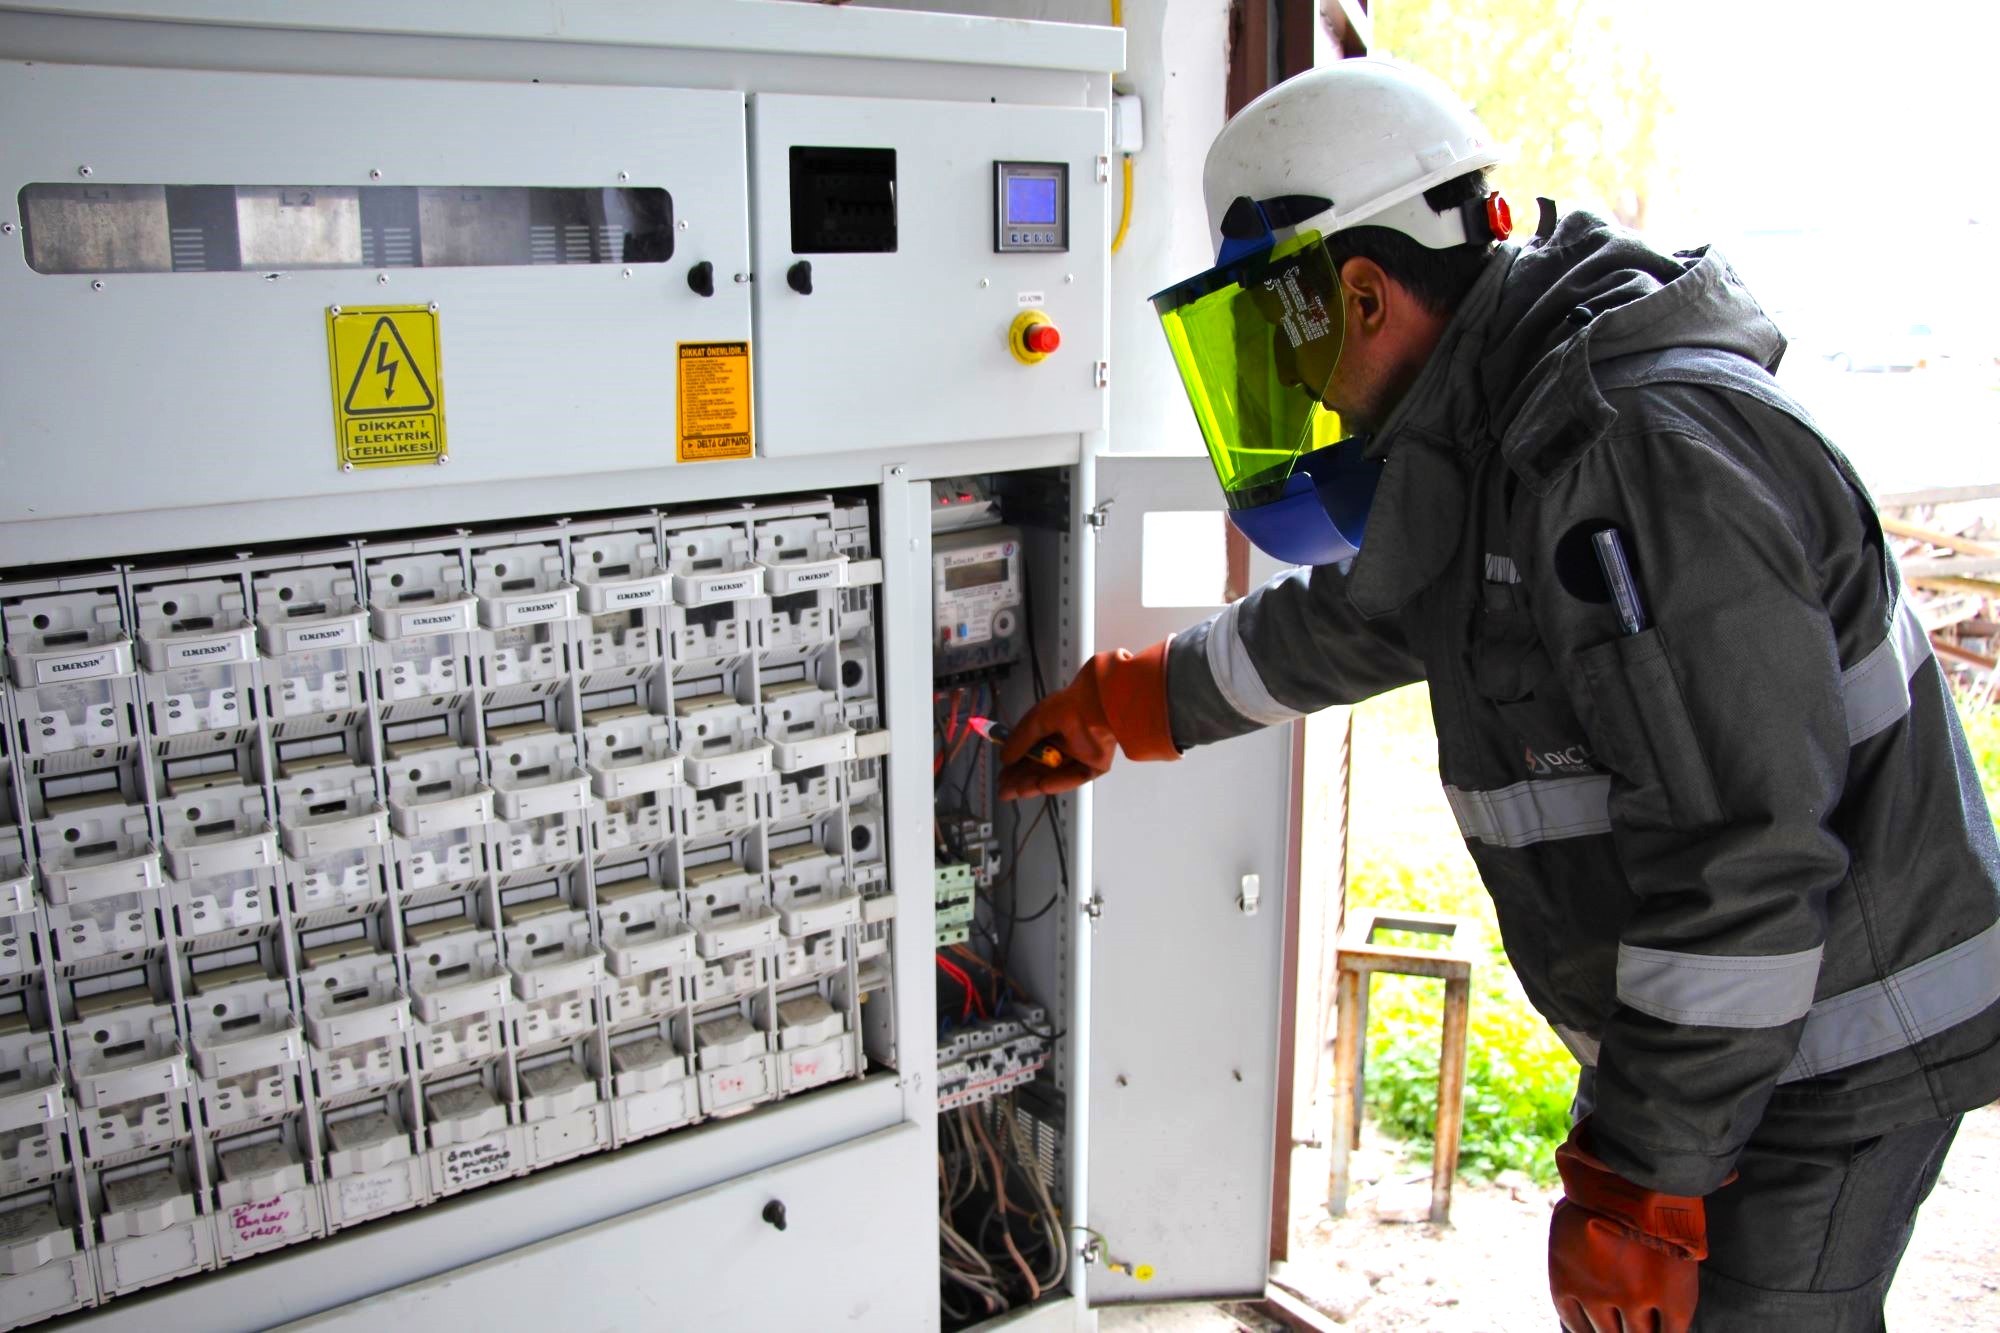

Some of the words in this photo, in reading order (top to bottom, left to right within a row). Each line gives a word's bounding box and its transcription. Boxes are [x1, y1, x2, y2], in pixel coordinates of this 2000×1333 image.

[358, 420, 416, 432] DİKKAT
[354, 431, 431, 444] ELEKTRİK
[353, 441, 434, 456] TEHLİKESİ
